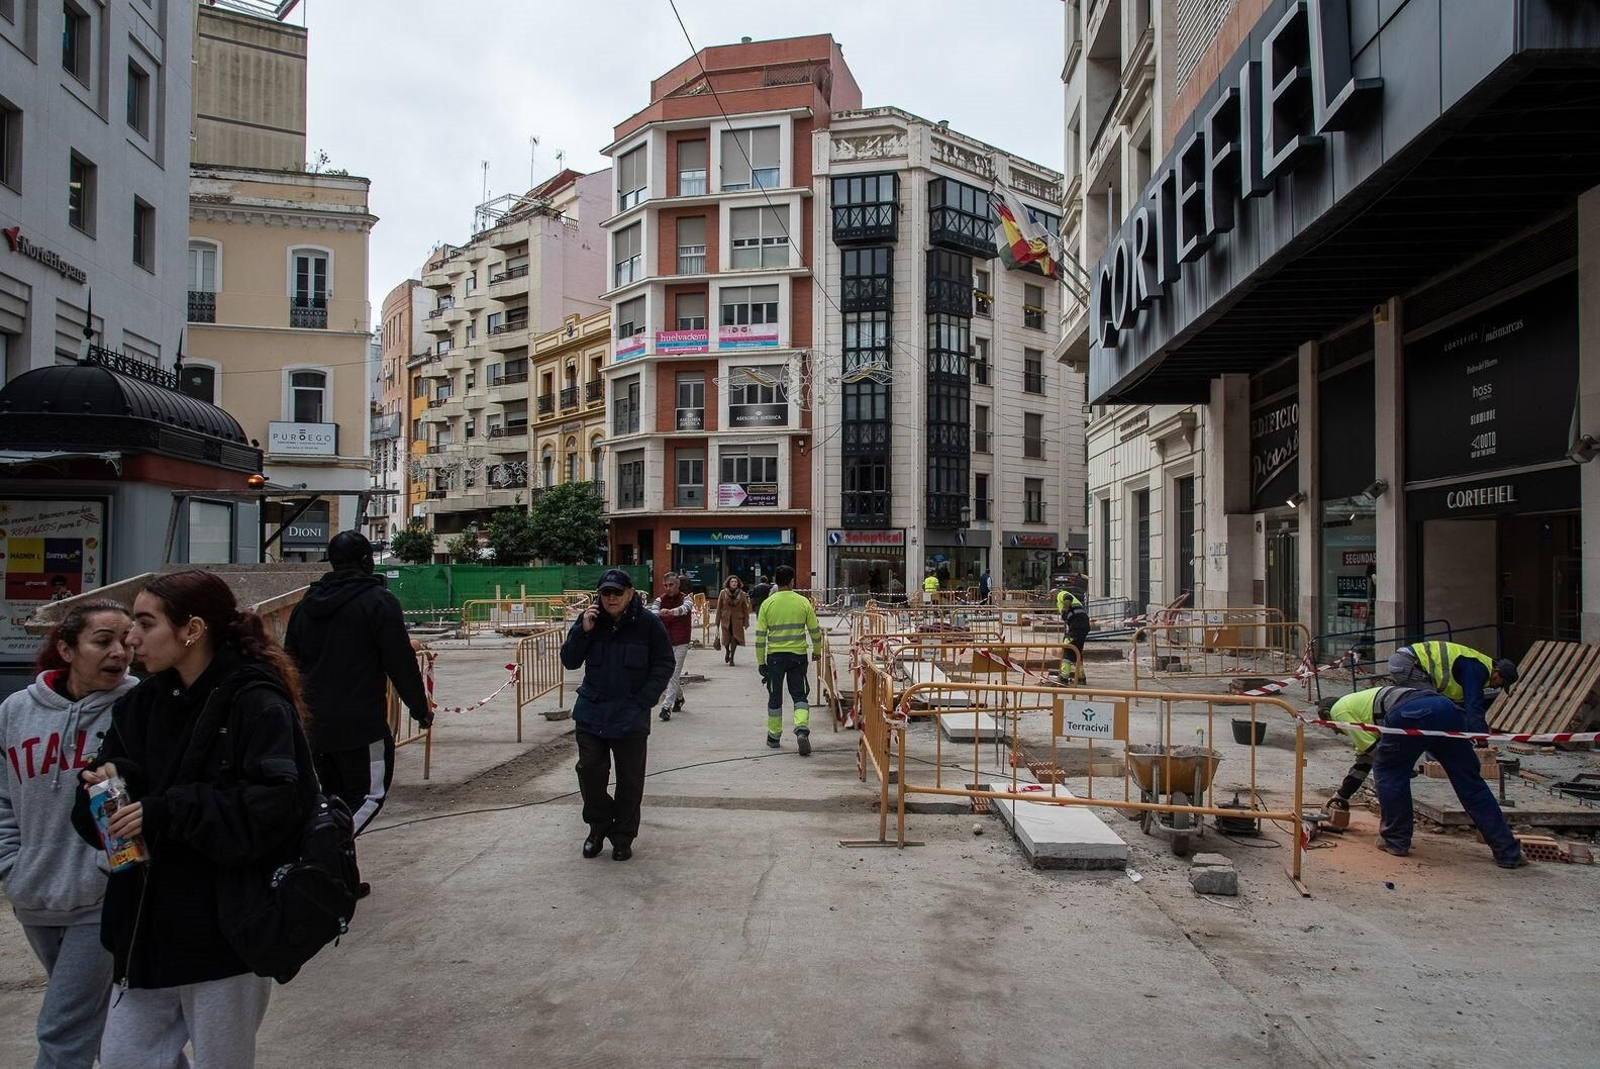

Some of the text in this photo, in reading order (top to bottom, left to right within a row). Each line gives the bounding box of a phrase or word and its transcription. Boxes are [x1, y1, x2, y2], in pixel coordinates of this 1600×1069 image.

[1099, 0, 1384, 348] CORTEFIEL
[21, 238, 88, 283] NorteHispana
[1485, 318, 1524, 342] mismarcas
[1472, 382, 1493, 398] hoss
[1252, 403, 1299, 438] EDIFICIO
[273, 433, 331, 442] PUROEGO
[1447, 485, 1518, 509] CORTEFIEL
[11, 523, 57, 536] REGALOS
[723, 533, 750, 541] movistar
[845, 531, 902, 543] Soloptical
[1338, 578, 1367, 591] REBAJAS
[1067, 721, 1109, 733] Terracivil
[8, 731, 91, 784] ITAL
